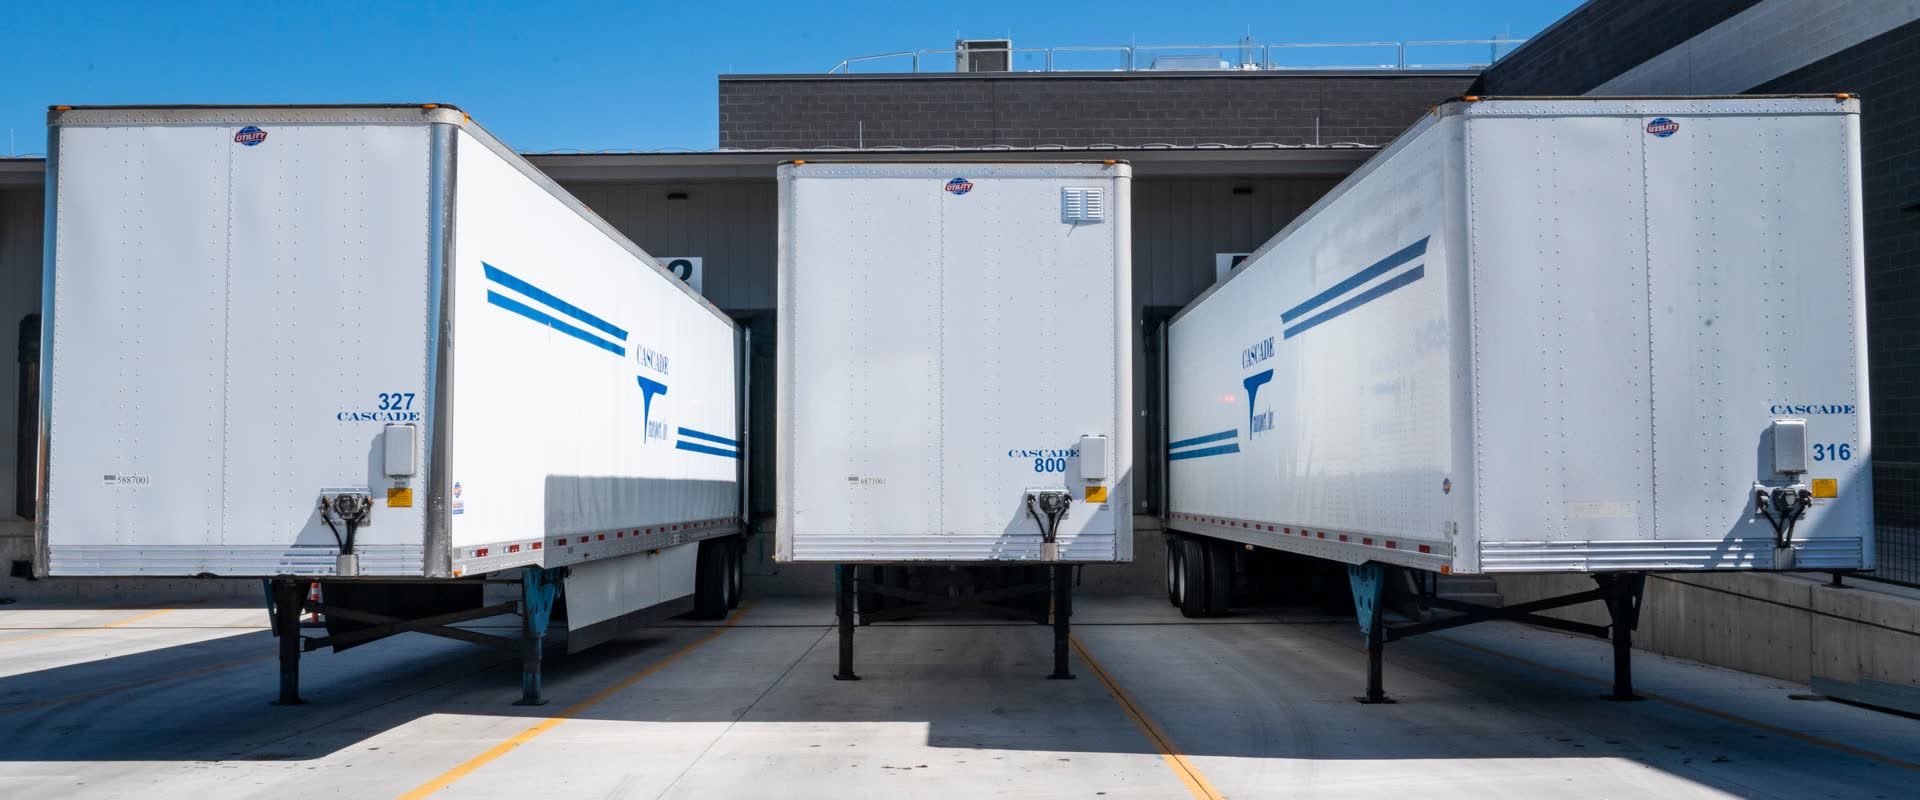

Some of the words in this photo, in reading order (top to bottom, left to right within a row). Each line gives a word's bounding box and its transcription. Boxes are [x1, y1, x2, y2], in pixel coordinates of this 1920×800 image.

[235, 131, 267, 142] UTILITY
[1242, 336, 1275, 369] CASCADE
[636, 343, 669, 375] CASCADE
[378, 392, 415, 410] 327
[1770, 404, 1855, 415] CASCADE
[337, 411, 420, 421] CASCADE
[1008, 448, 1080, 458] CASCADE
[1813, 443, 1851, 461] 316
[1034, 458, 1066, 472] 800
[116, 475, 149, 485] 5887001
